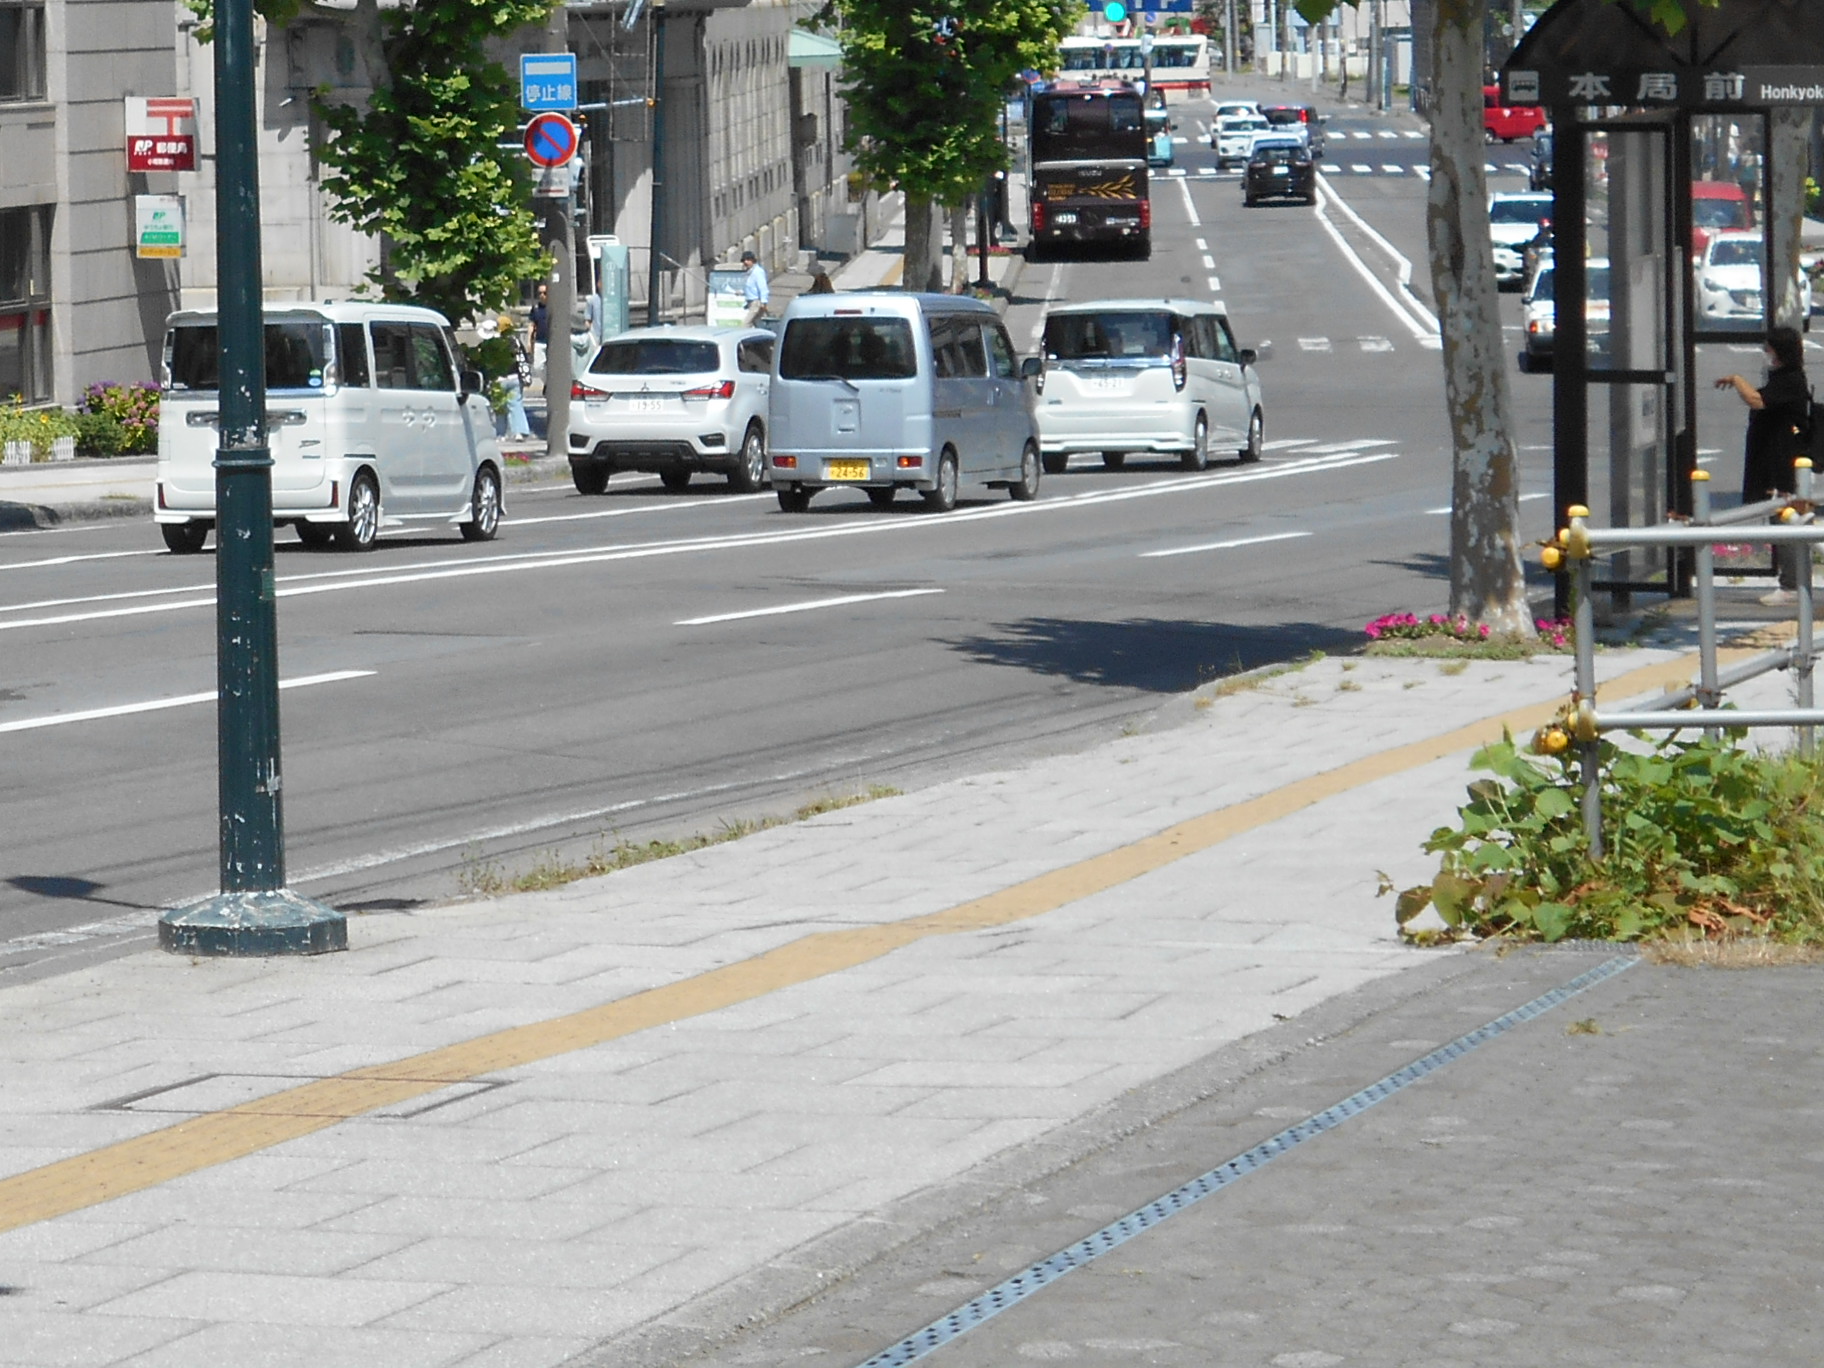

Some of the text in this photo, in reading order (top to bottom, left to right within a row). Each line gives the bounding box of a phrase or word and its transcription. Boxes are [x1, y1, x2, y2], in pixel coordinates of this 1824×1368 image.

[526, 83, 573, 102] 停止線
[1569, 72, 1746, 100] 本局前
